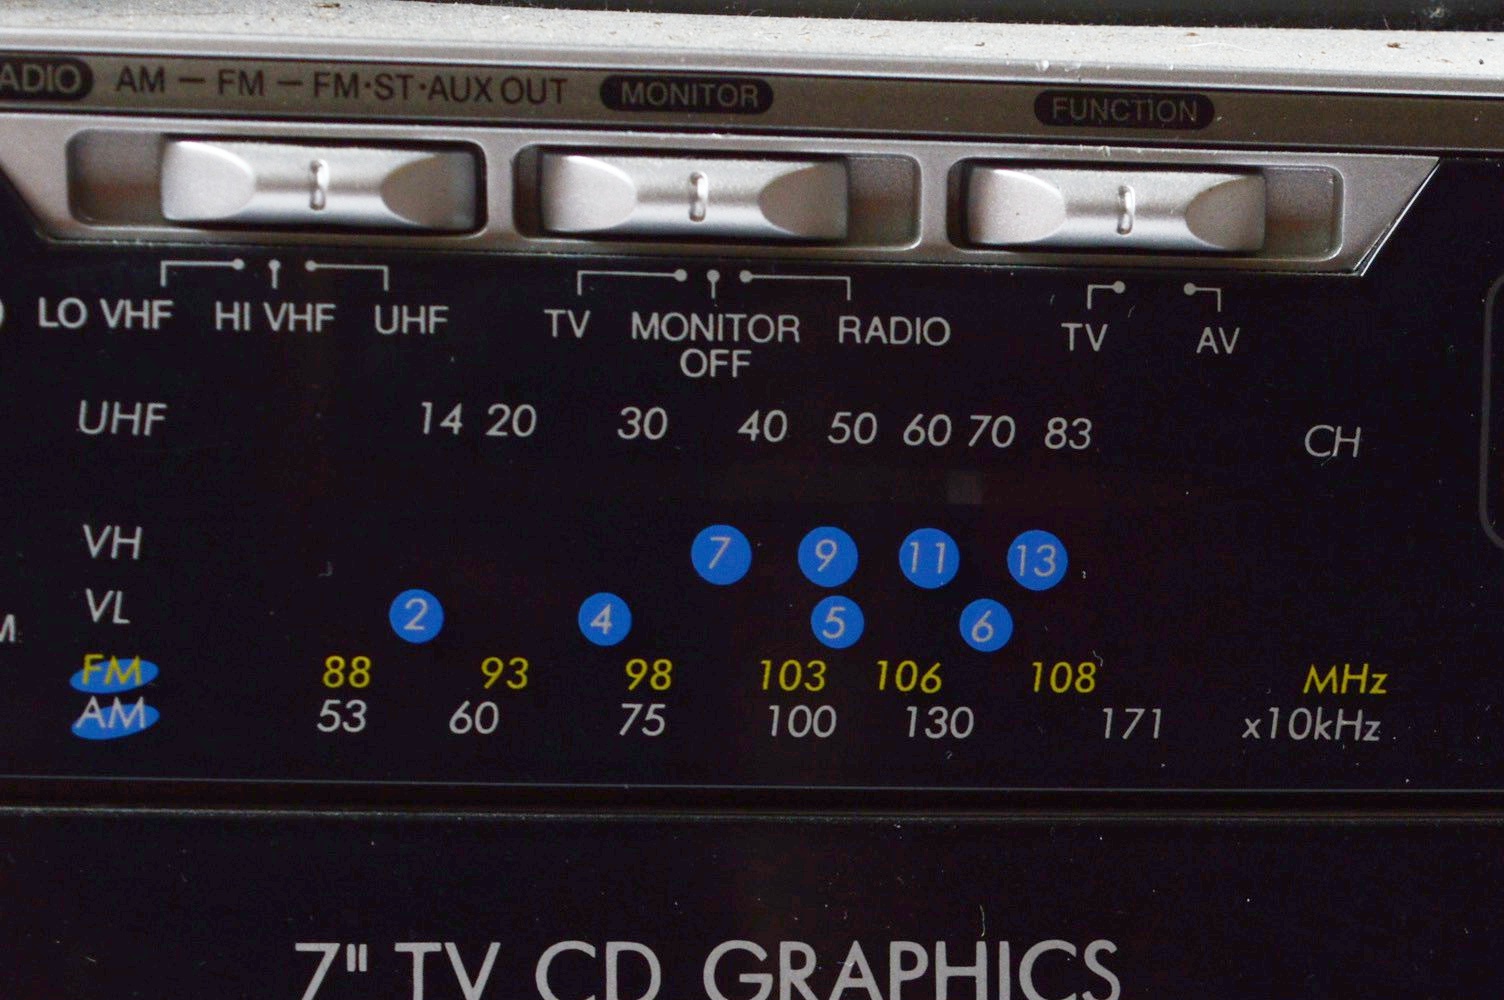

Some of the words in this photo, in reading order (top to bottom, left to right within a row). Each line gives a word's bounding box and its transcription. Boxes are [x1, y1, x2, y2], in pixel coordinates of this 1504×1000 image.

[116, 67, 165, 93] AM
[218, 70, 263, 96] FM
[501, 76, 566, 105] OUT
[621, 83, 760, 108] MONITOR
[1052, 96, 1198, 123] FUNCTION
[39, 297, 87, 328] LO
[100, 299, 173, 329] VHF
[216, 301, 250, 330] HI
[264, 302, 336, 331] VHF
[375, 305, 448, 334] UHF
[544, 309, 590, 338] TV
[632, 312, 799, 343] MONITOR
[839, 316, 950, 346] RADIO
[1061, 323, 1108, 351] TV
[1196, 327, 1240, 354] AV
[680, 349, 751, 377] OFF
[79, 400, 167, 435] UHF
[422, 402, 462, 434] 14
[486, 404, 536, 437] 20
[618, 407, 667, 440] 30
[738, 410, 787, 442] 40
[828, 412, 877, 444] 50
[903, 414, 951, 446] 60
[969, 415, 1015, 447] 70
[1045, 417, 1091, 449] 83
[1305, 425, 1361, 457] CH
[83, 524, 141, 559] VH
[709, 536, 731, 569] 7
[815, 539, 837, 571] 9
[911, 541, 946, 574] 11
[1017, 544, 1056, 577] 13
[86, 589, 130, 624] VL
[404, 598, 428, 630] 2
[591, 604, 612, 634] 4
[823, 606, 845, 639] 5
[972, 610, 994, 642] 6
[82, 654, 142, 685] FM
[323, 656, 370, 688] 88
[481, 657, 528, 689] 93
[626, 659, 672, 690] 98
[761, 660, 826, 691] 103
[878, 660, 941, 693] 106
[1033, 662, 1096, 693] 108
[1304, 664, 1387, 694] MHz
[75, 696, 145, 728] AM
[317, 699, 366, 732] 53
[450, 701, 498, 734] 60
[620, 703, 665, 736] 75
[769, 705, 836, 737] 100
[907, 706, 974, 738] 130
[1103, 708, 1161, 739] 171
